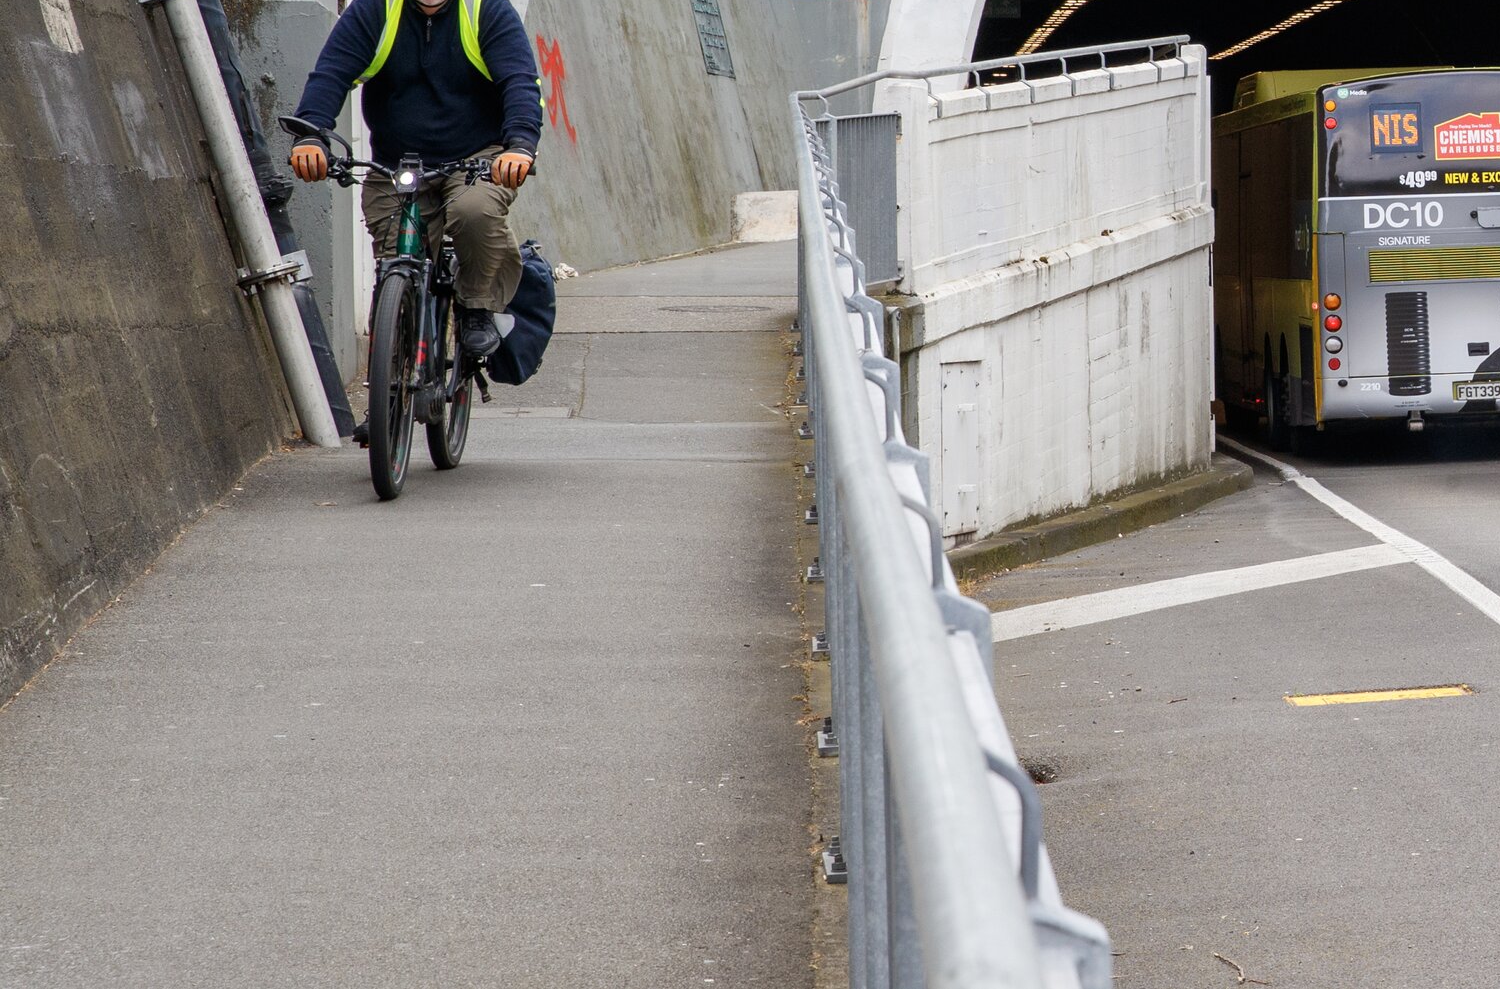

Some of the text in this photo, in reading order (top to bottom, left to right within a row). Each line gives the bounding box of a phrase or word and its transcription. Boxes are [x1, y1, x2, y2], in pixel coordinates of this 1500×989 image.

[1373, 113, 1418, 146] NIS
[1444, 173, 1469, 184] NEW
[1471, 172, 1480, 183] &
[1363, 201, 1444, 229] DC10
[1378, 235, 1431, 246] SIGNATURE
[1360, 382, 1381, 392] 2210
